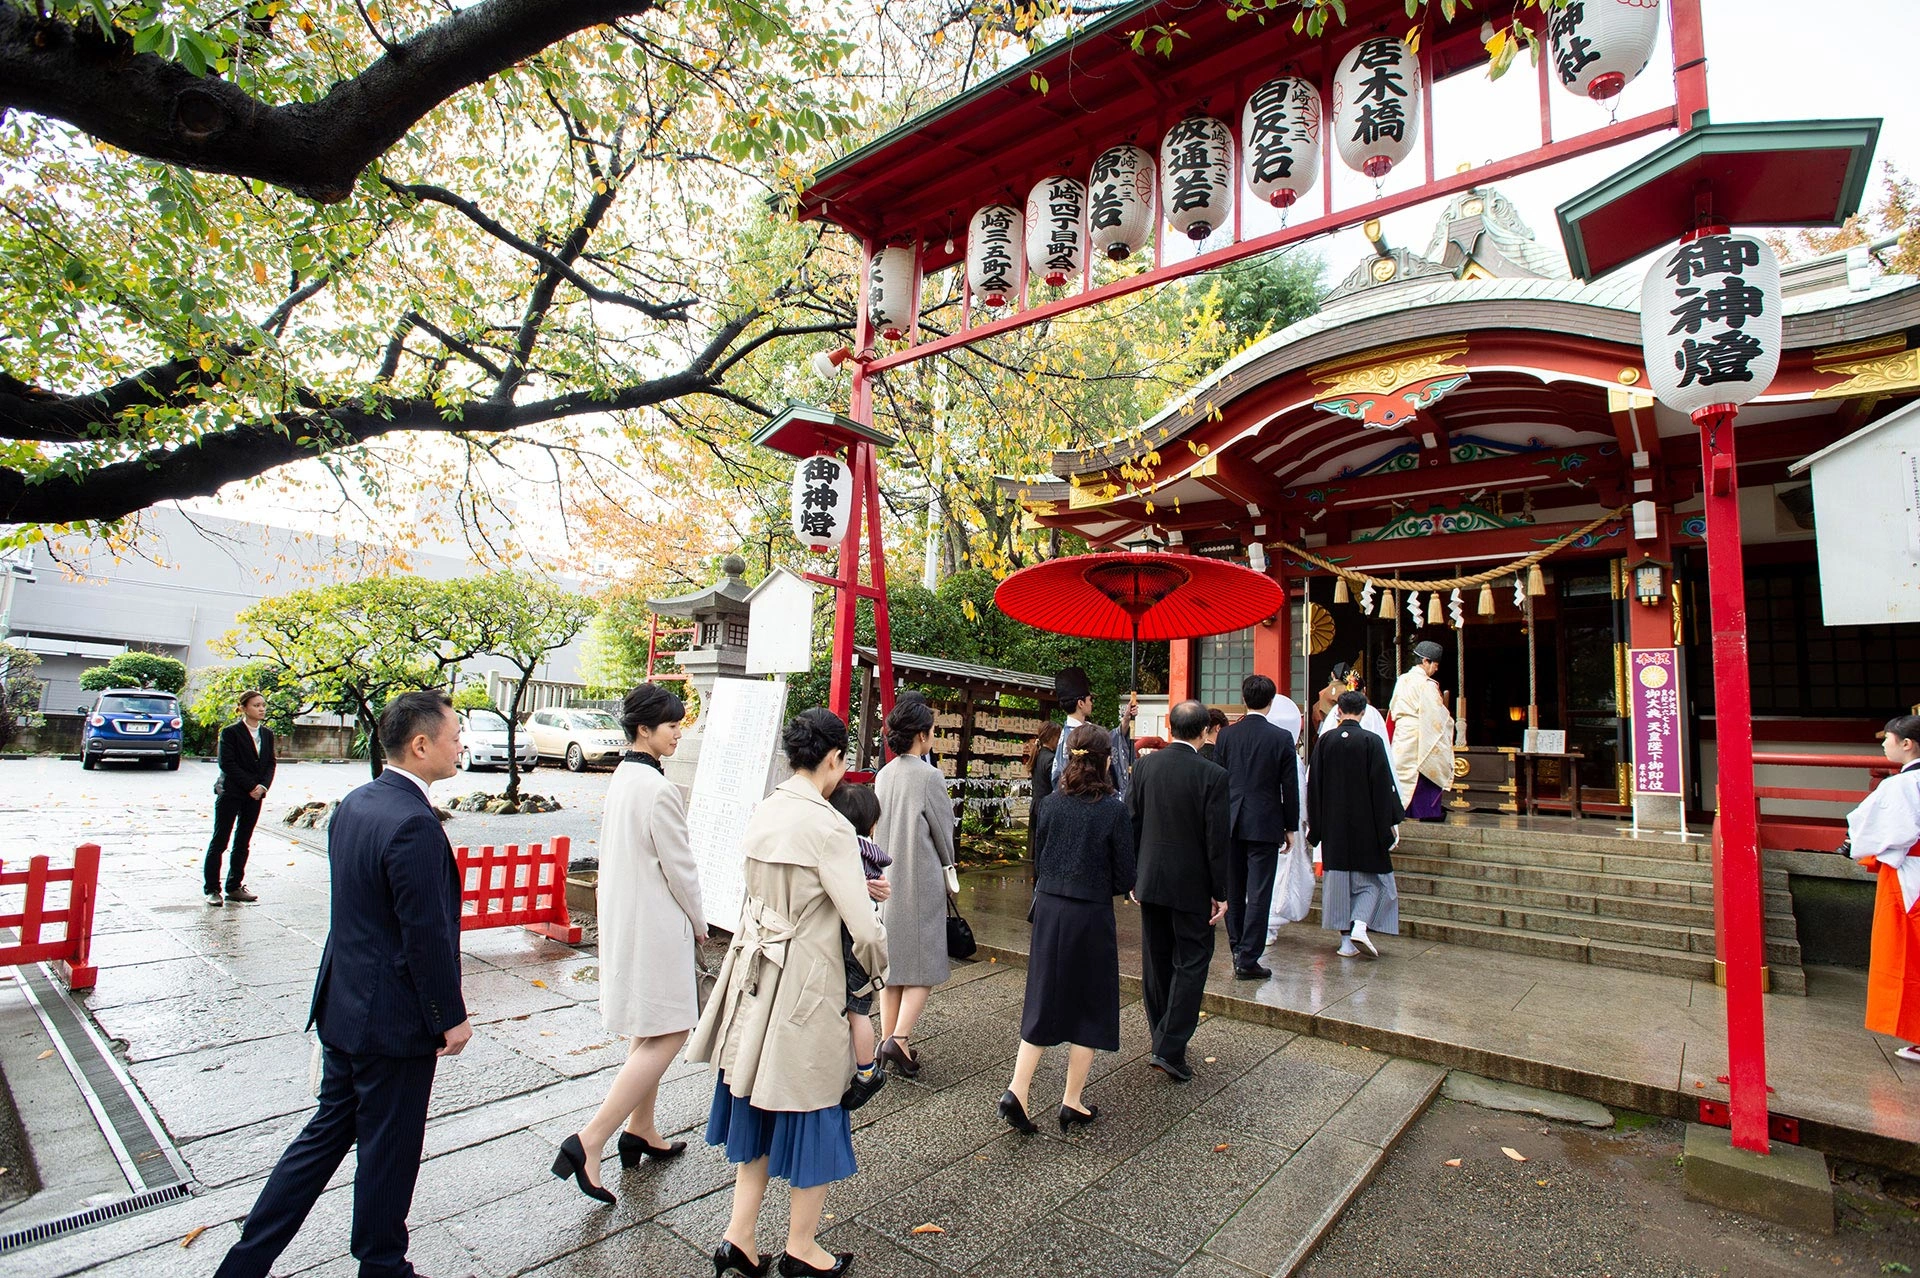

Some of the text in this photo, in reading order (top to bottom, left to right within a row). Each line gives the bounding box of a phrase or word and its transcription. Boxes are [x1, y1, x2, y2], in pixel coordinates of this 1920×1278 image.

[1350, 36, 1408, 145] 居木橋
[1045, 175, 1084, 272] 大崎四丁目町会
[1665, 236, 1765, 388] 御神燈
[801, 457, 841, 538] 御神燈
[1646, 721, 1665, 791] 天皇陛下御即位
